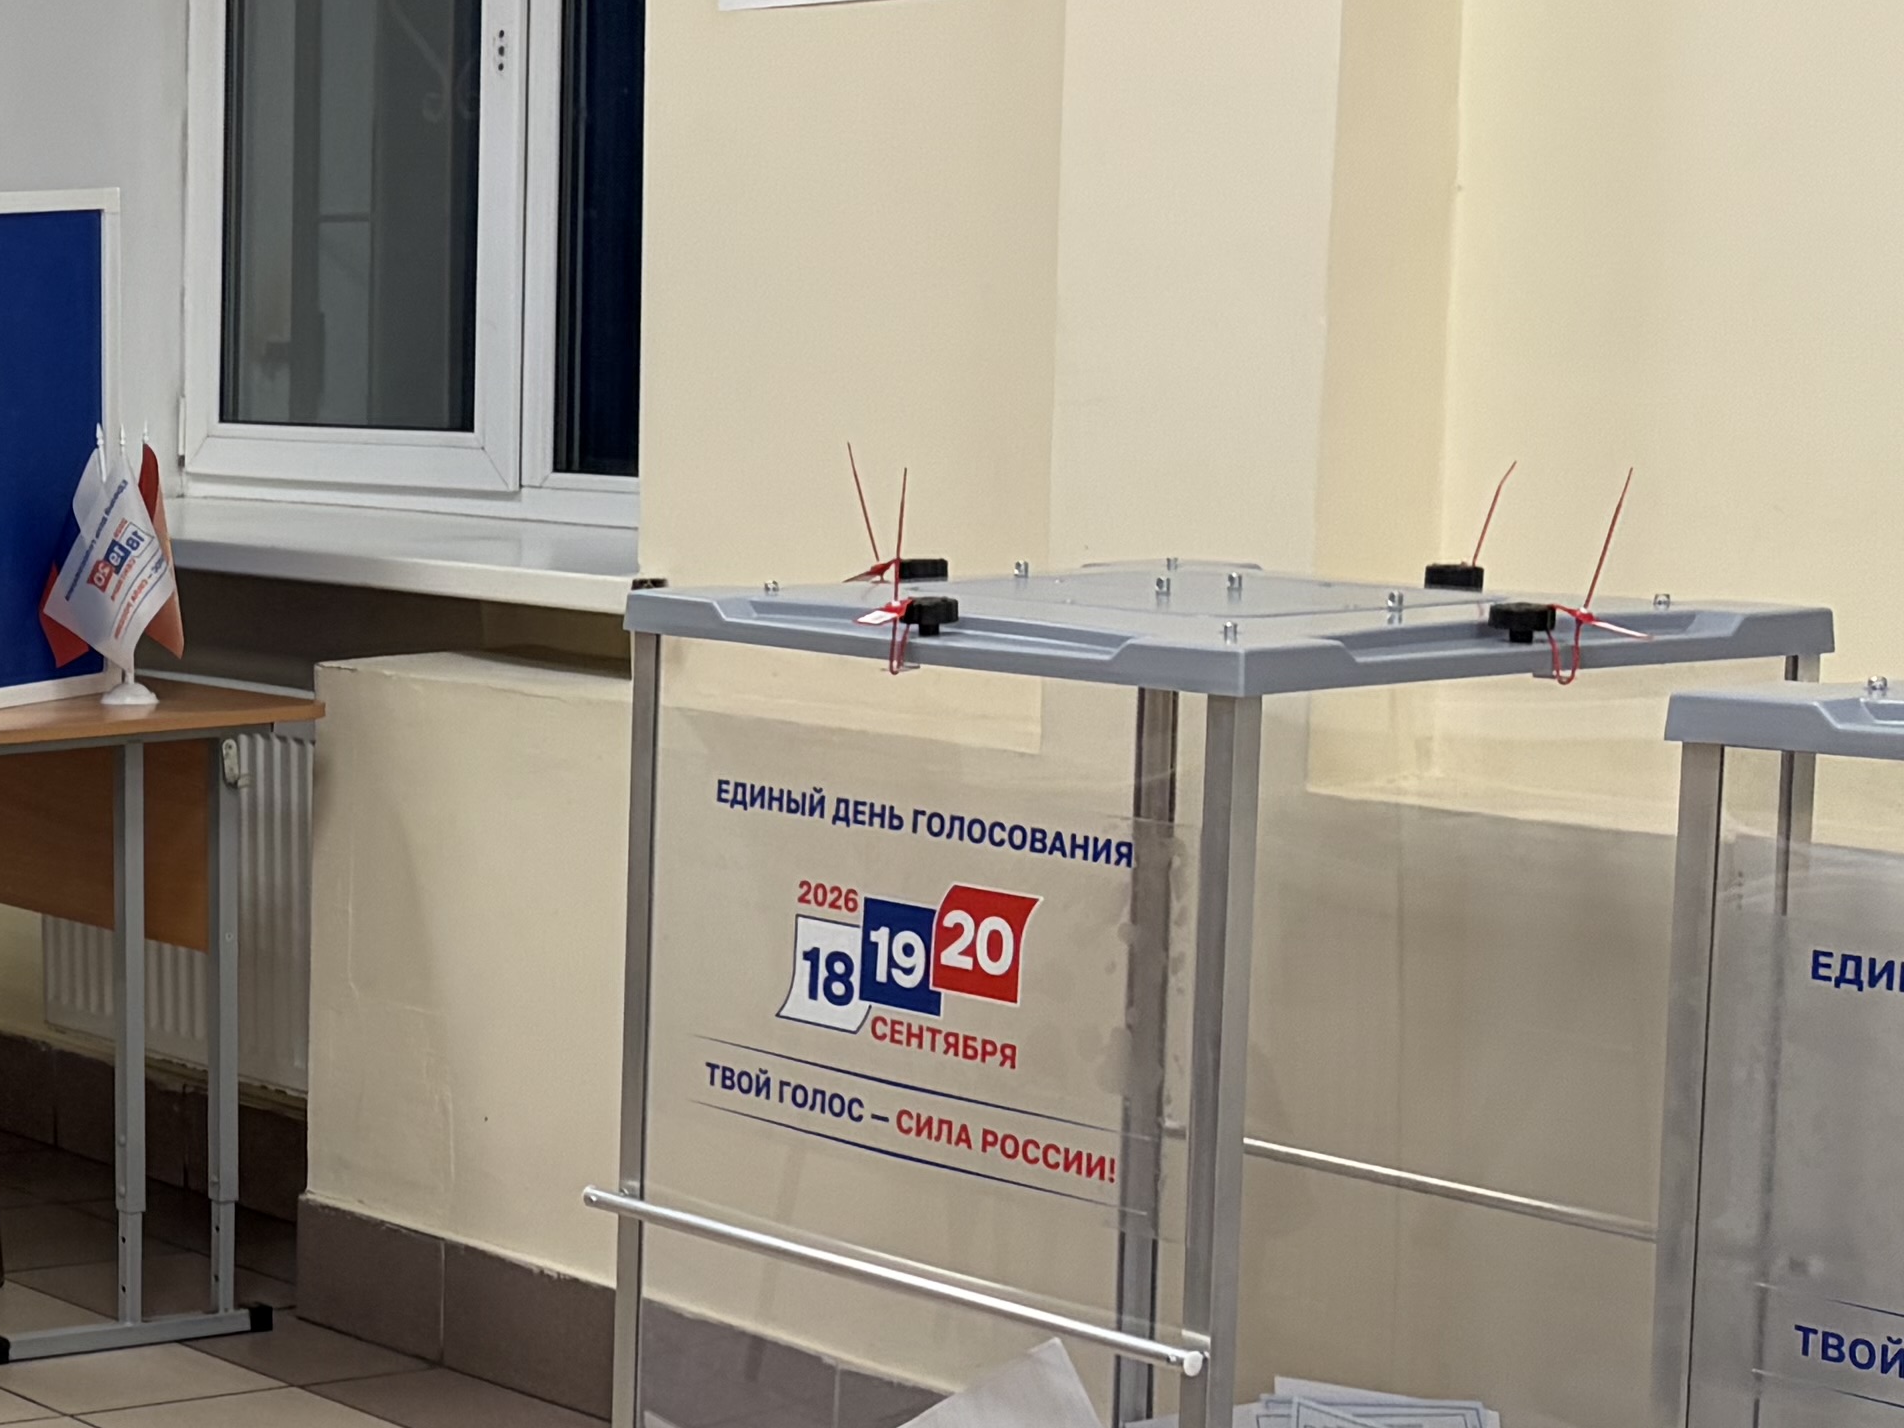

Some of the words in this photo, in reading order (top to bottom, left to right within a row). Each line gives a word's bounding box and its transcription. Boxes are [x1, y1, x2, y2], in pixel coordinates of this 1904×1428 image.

[716, 779, 826, 819] ЕДИНЫЙ
[831, 797, 904, 831] ДЕНЬ
[911, 808, 1134, 868] ГОЛОСОВАНИЯ
[797, 879, 859, 912] 2026
[802, 946, 855, 1007] 18
[869, 926, 926, 988] 19
[940, 909, 1014, 976] 20
[870, 1015, 1017, 1070] СЕНТЯБРЯ
[705, 1062, 771, 1101] ТВОЙ
[778, 1080, 864, 1122] ГОЛОС
[896, 1109, 973, 1150] СИЛА
[981, 1128, 1116, 1183] РОССИИ!
[1794, 1324, 1904, 1379] ТВОЙ
